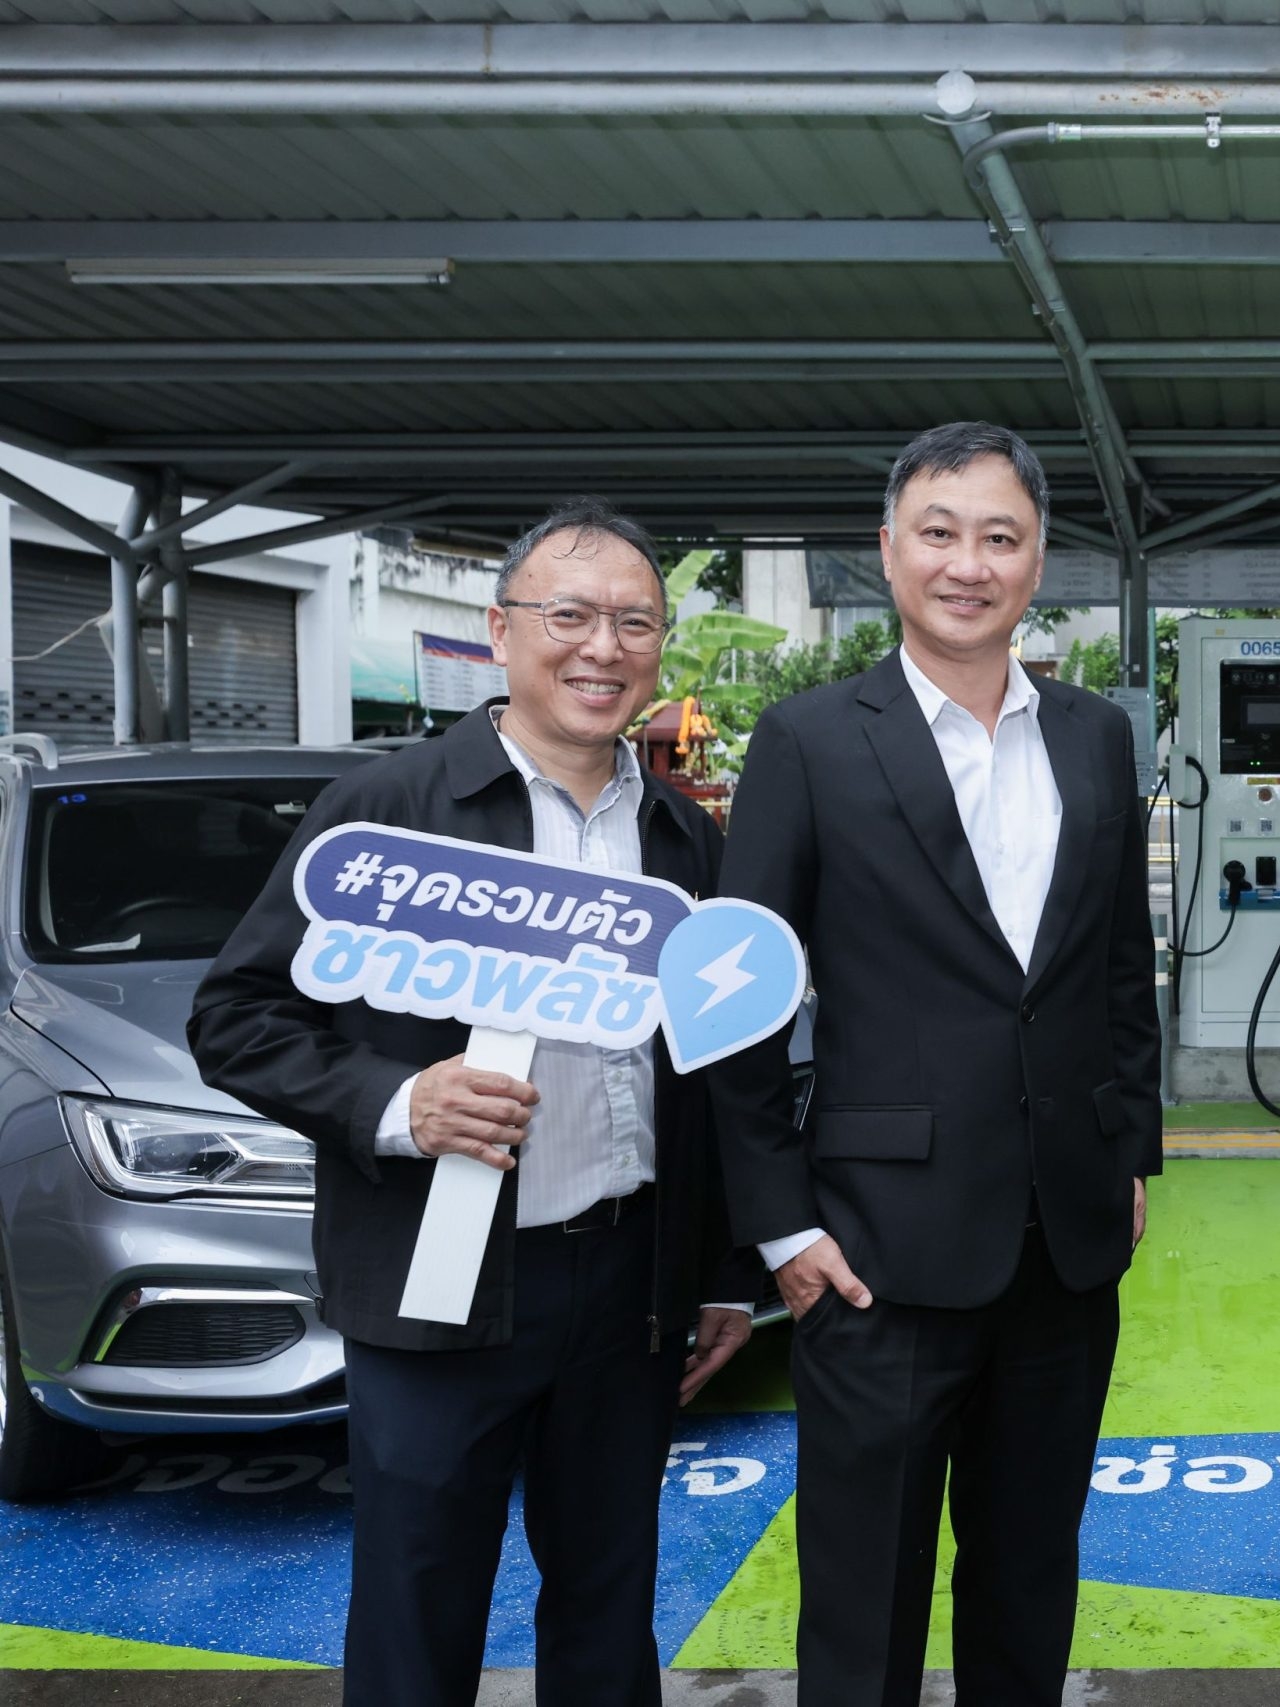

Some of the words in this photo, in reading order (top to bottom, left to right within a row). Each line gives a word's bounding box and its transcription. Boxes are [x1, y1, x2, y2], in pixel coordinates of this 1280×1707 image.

[333, 851, 653, 946] #จุดรวมตัว
[311, 928, 657, 1033] ชาวพลัซ
